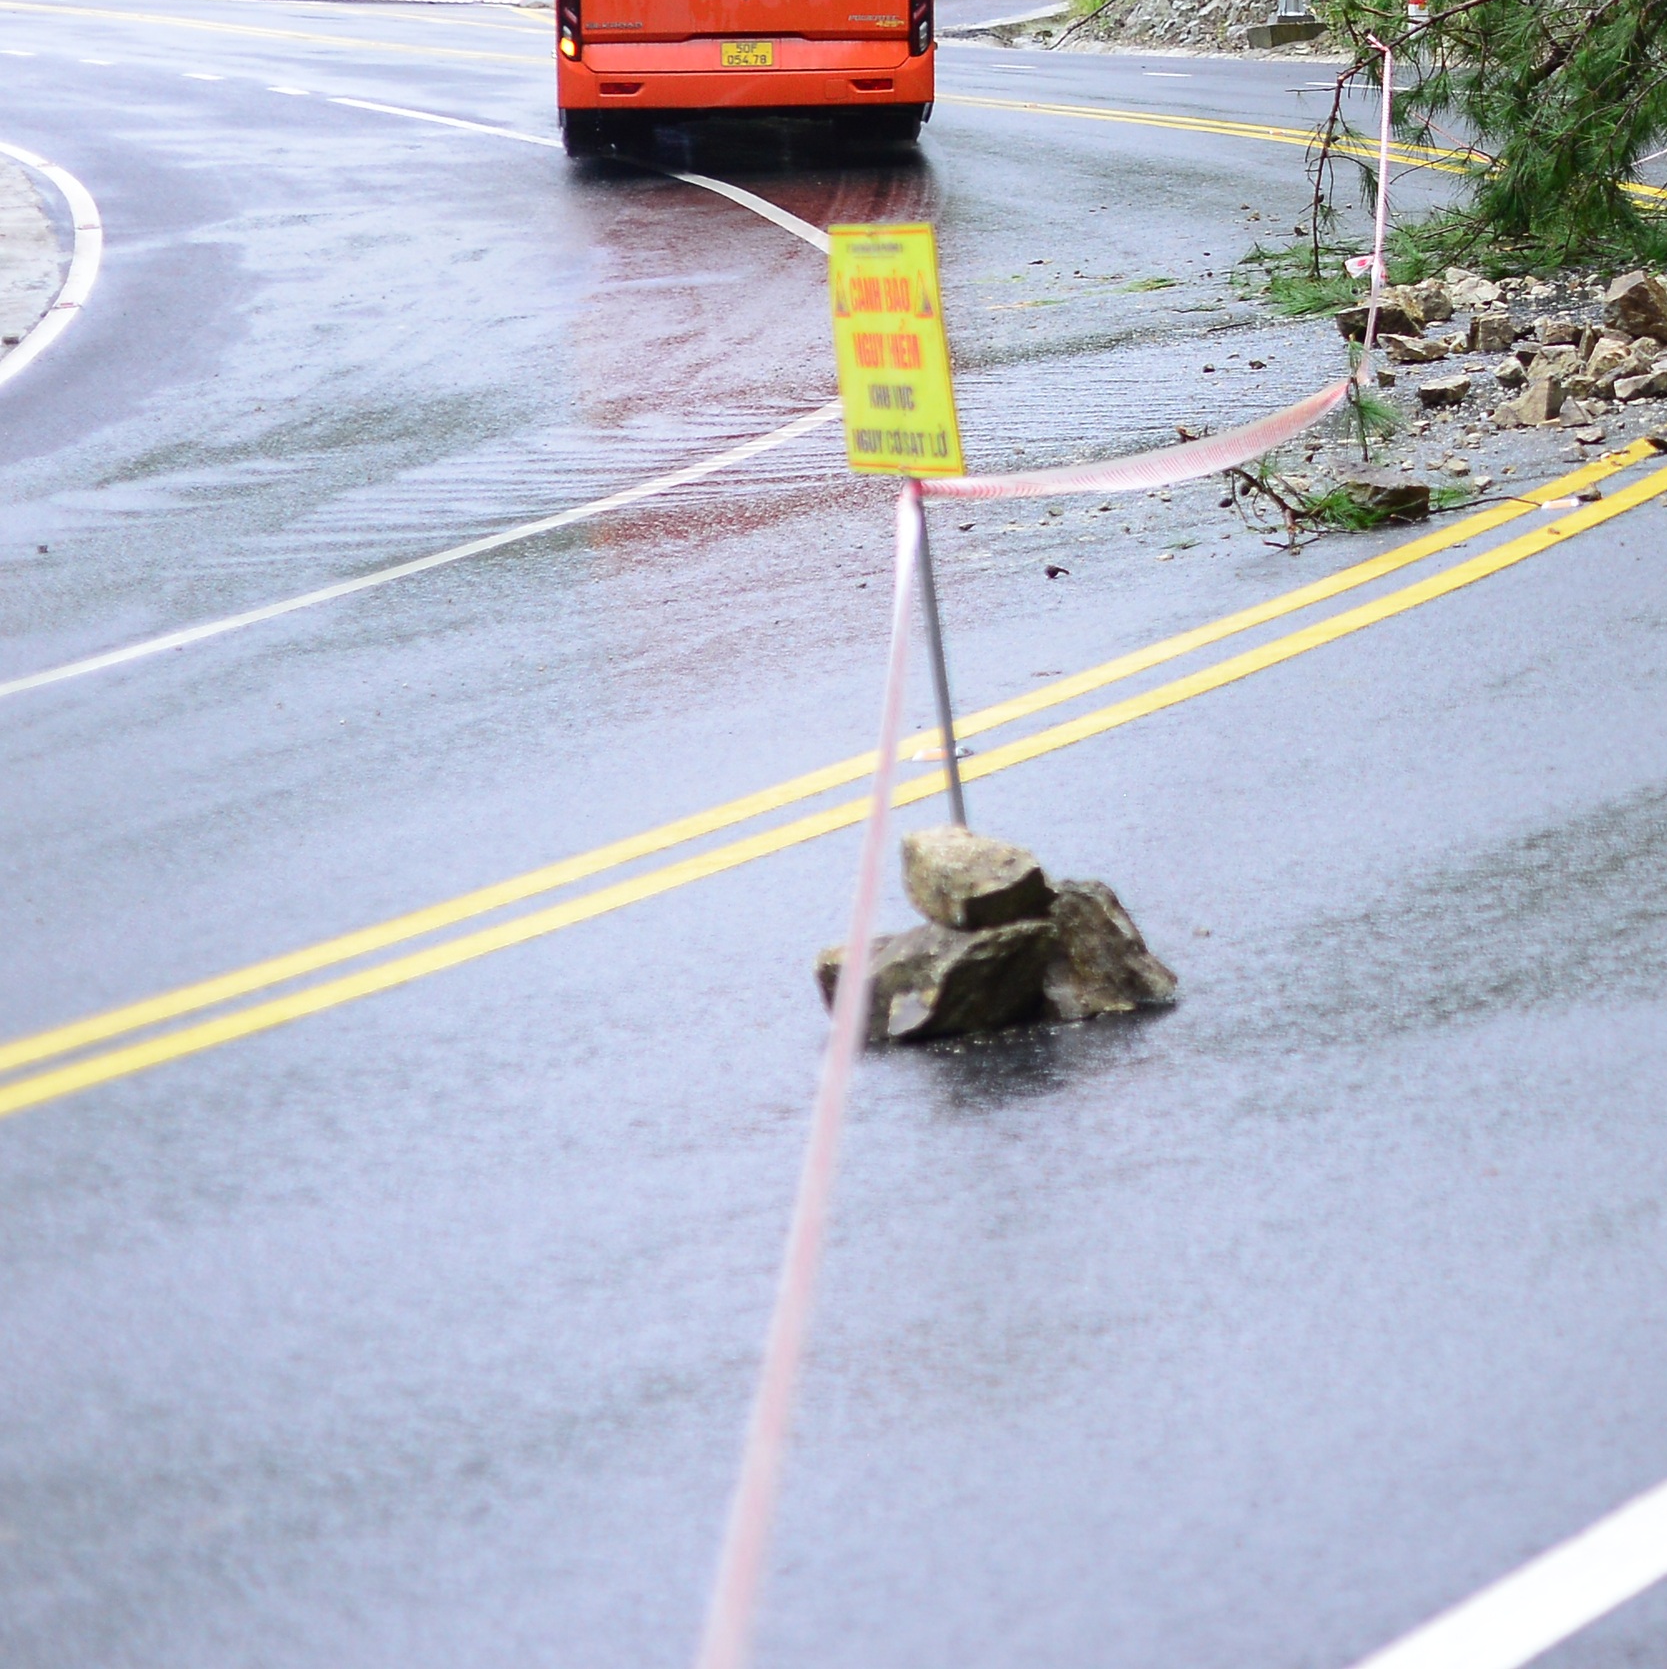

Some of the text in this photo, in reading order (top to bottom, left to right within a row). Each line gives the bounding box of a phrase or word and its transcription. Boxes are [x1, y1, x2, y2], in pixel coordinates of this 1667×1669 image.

[735, 43, 757, 54] 50F
[727, 54, 767, 65] 054.78
[852, 333, 884, 368] NGUY
[852, 428, 883, 453] NGUY
